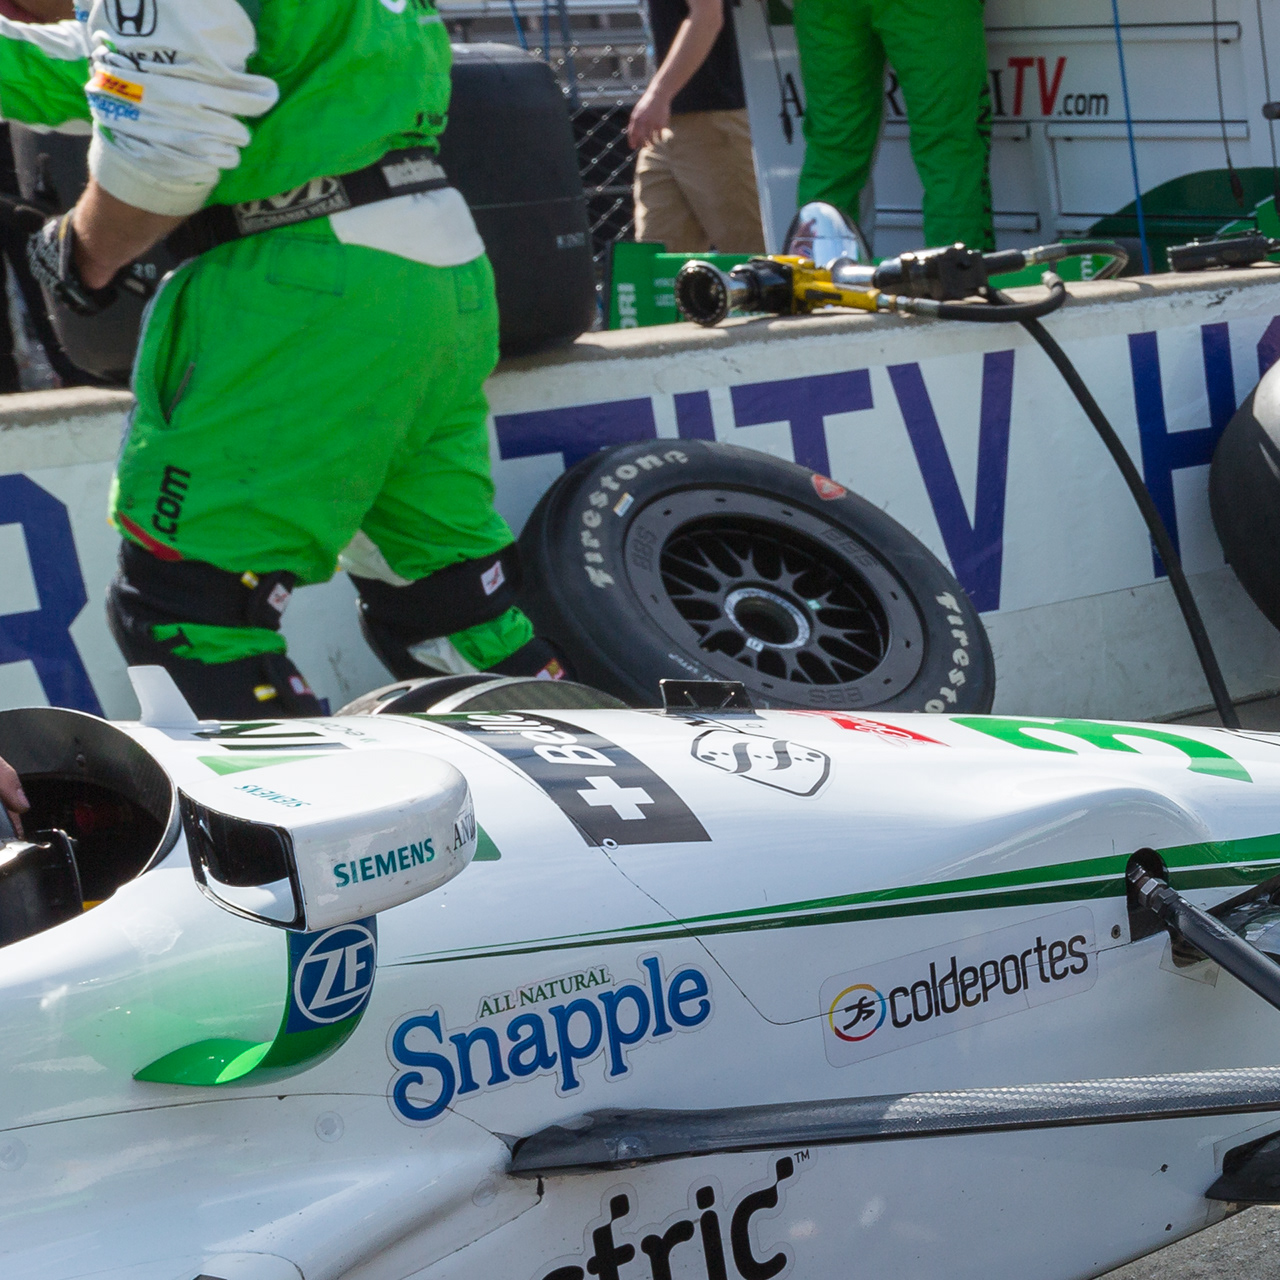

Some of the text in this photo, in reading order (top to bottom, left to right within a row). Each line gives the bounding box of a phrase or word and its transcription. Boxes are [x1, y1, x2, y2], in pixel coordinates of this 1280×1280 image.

[151, 464, 191, 542] .com
[333, 837, 436, 888] SIEMENS
[308, 946, 370, 1004] ZF
[479, 968, 611, 1018] ALL NATURAL
[888, 934, 1089, 1029] coldeportes
[393, 957, 710, 1121] Snapple
